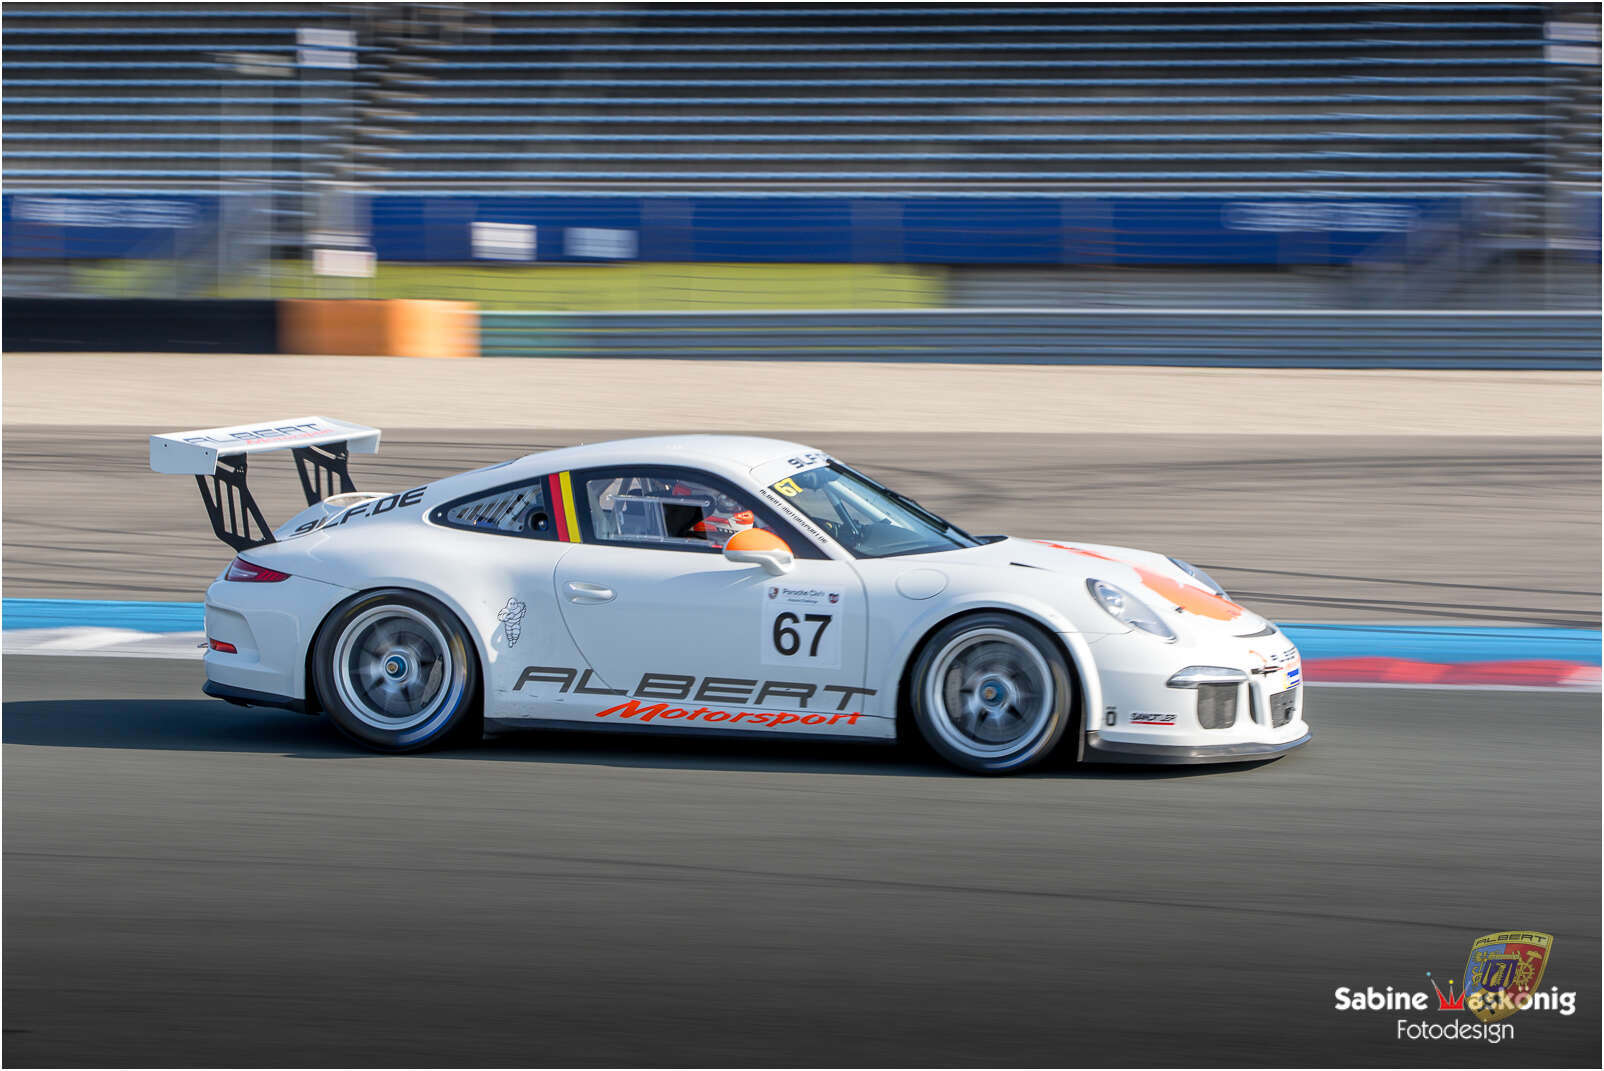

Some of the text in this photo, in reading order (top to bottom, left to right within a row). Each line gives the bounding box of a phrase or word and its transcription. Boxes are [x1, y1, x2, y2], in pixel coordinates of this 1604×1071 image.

[773, 477, 804, 497] 67
[772, 611, 833, 657] 67
[512, 665, 878, 711] ALBERT
[595, 699, 866, 728] Motorsport
